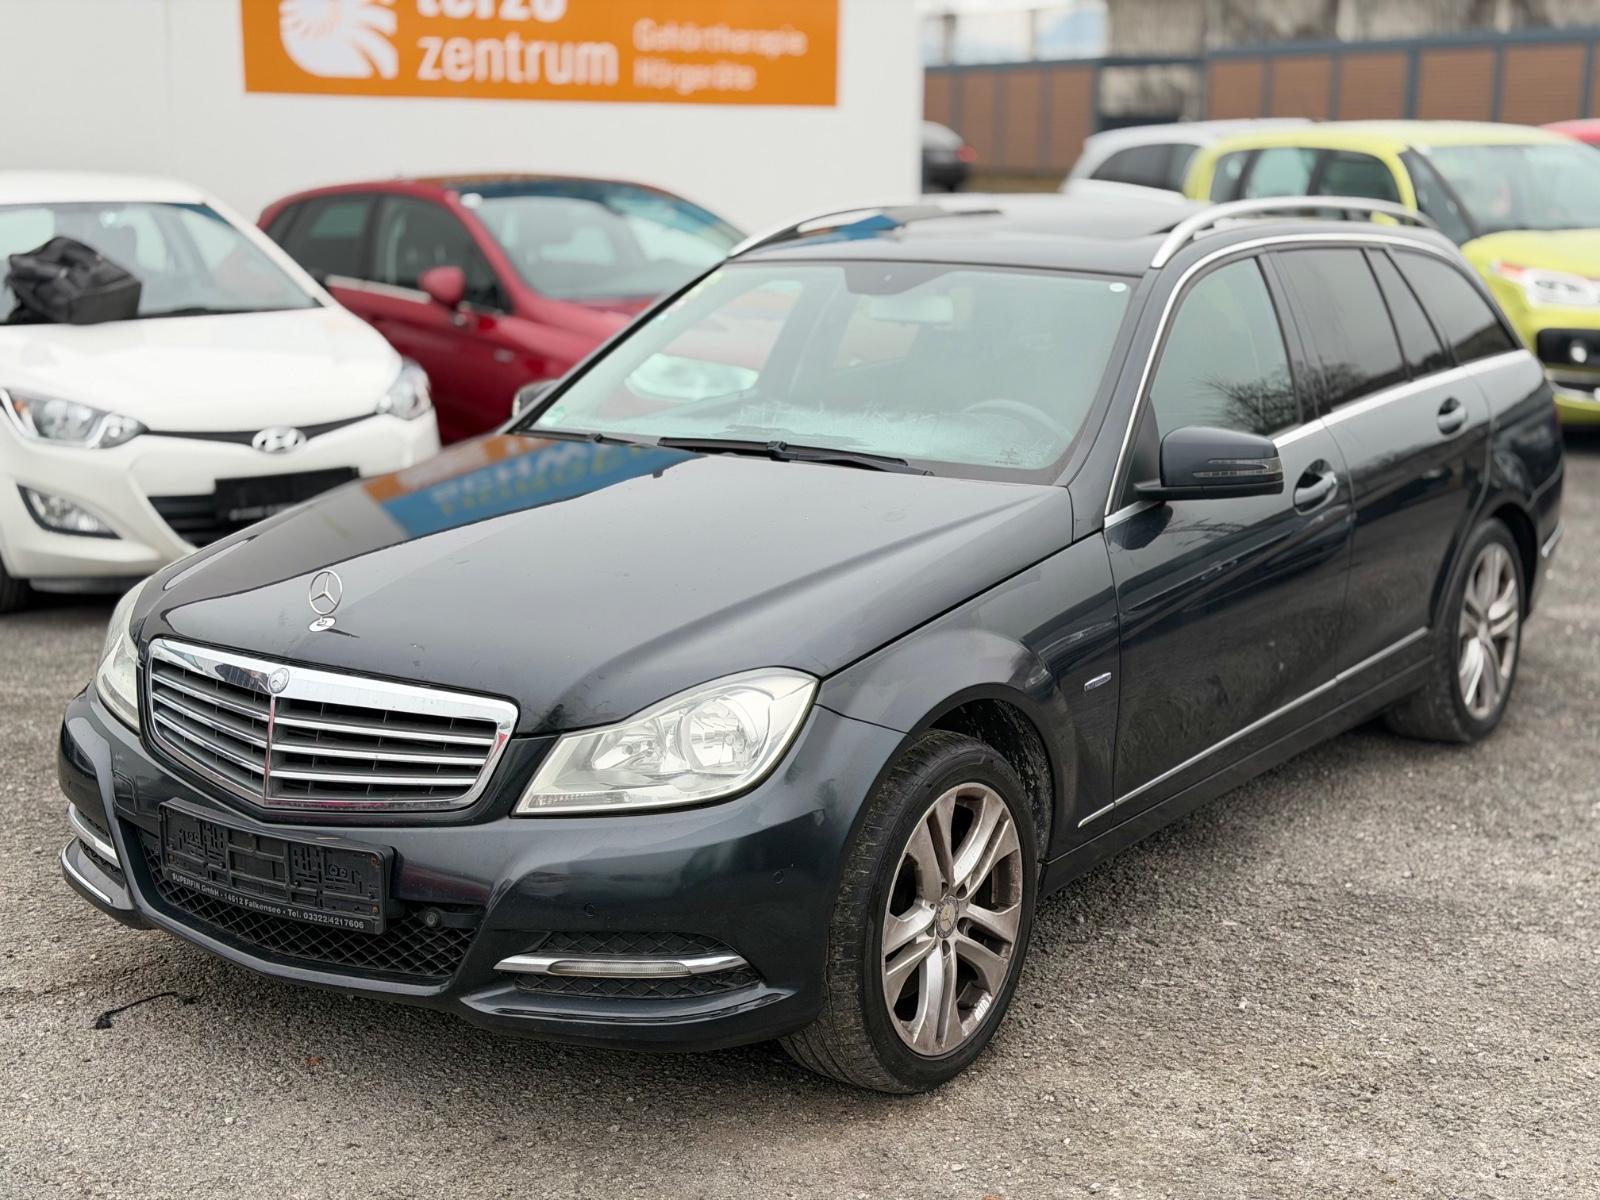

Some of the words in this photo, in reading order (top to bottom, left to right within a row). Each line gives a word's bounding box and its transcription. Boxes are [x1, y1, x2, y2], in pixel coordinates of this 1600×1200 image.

[416, 32, 619, 85] zentrum
[201, 885, 219, 897] GmbH
[244, 899, 281, 914] Falkensee
[287, 908, 302, 919] Tel.
